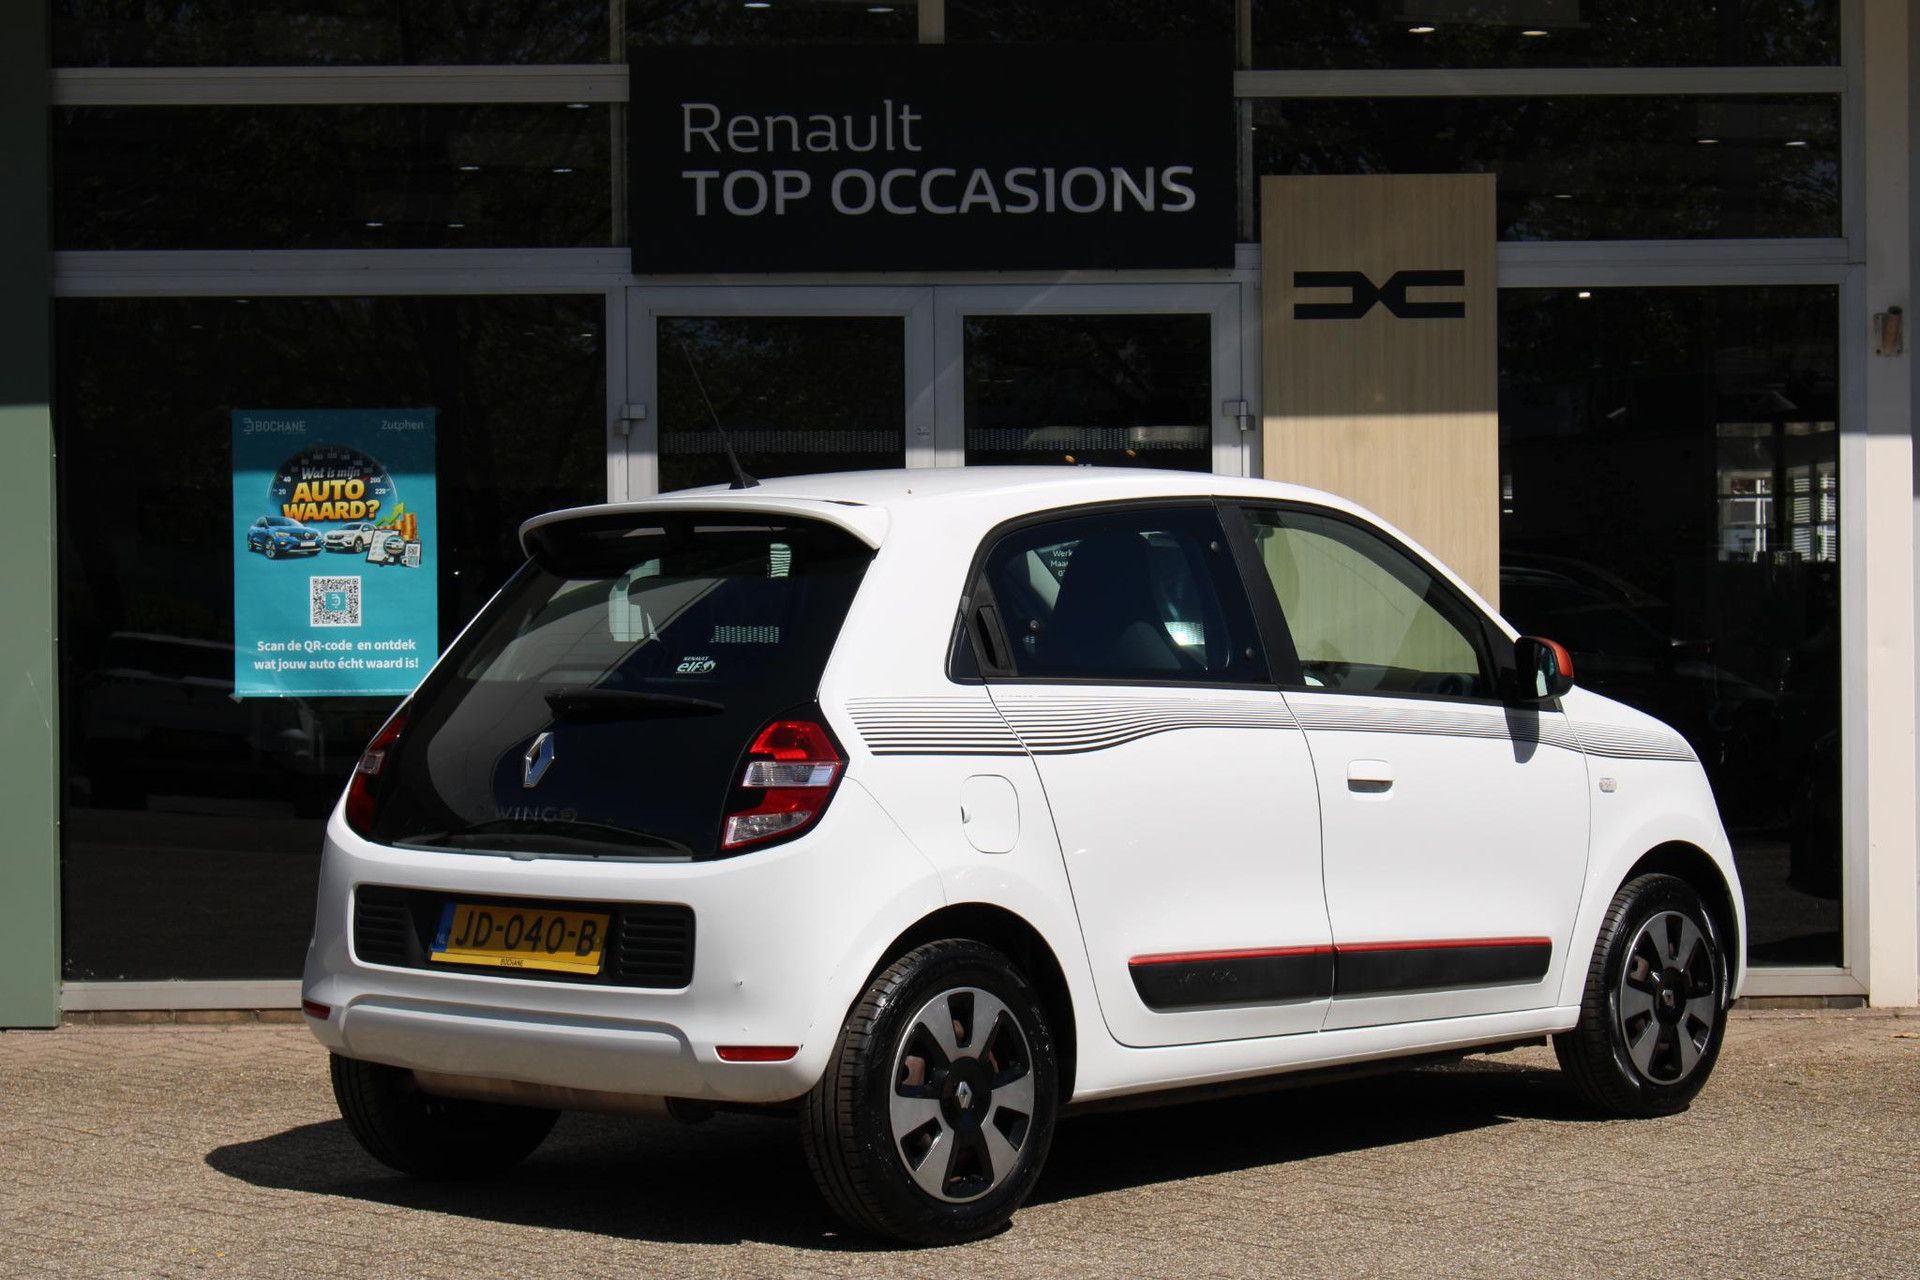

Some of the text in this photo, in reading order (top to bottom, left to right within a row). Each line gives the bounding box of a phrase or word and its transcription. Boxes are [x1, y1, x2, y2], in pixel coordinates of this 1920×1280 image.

[681, 100, 922, 152] Renault
[681, 165, 1196, 216] TOP OCCASIONS
[255, 420, 306, 432] BOCHANE
[381, 420, 424, 431] Zutphen
[302, 467, 325, 480] Wat
[327, 467, 334, 478] is
[337, 466, 360, 480] mijn
[292, 479, 365, 503] AUTO
[282, 500, 380, 521] WAARD?
[257, 639, 416, 653] Scan de QR-code en ontdek
[254, 657, 419, 671] wat jouw auto écht waard is!
[455, 911, 599, 956] JD-040-B
